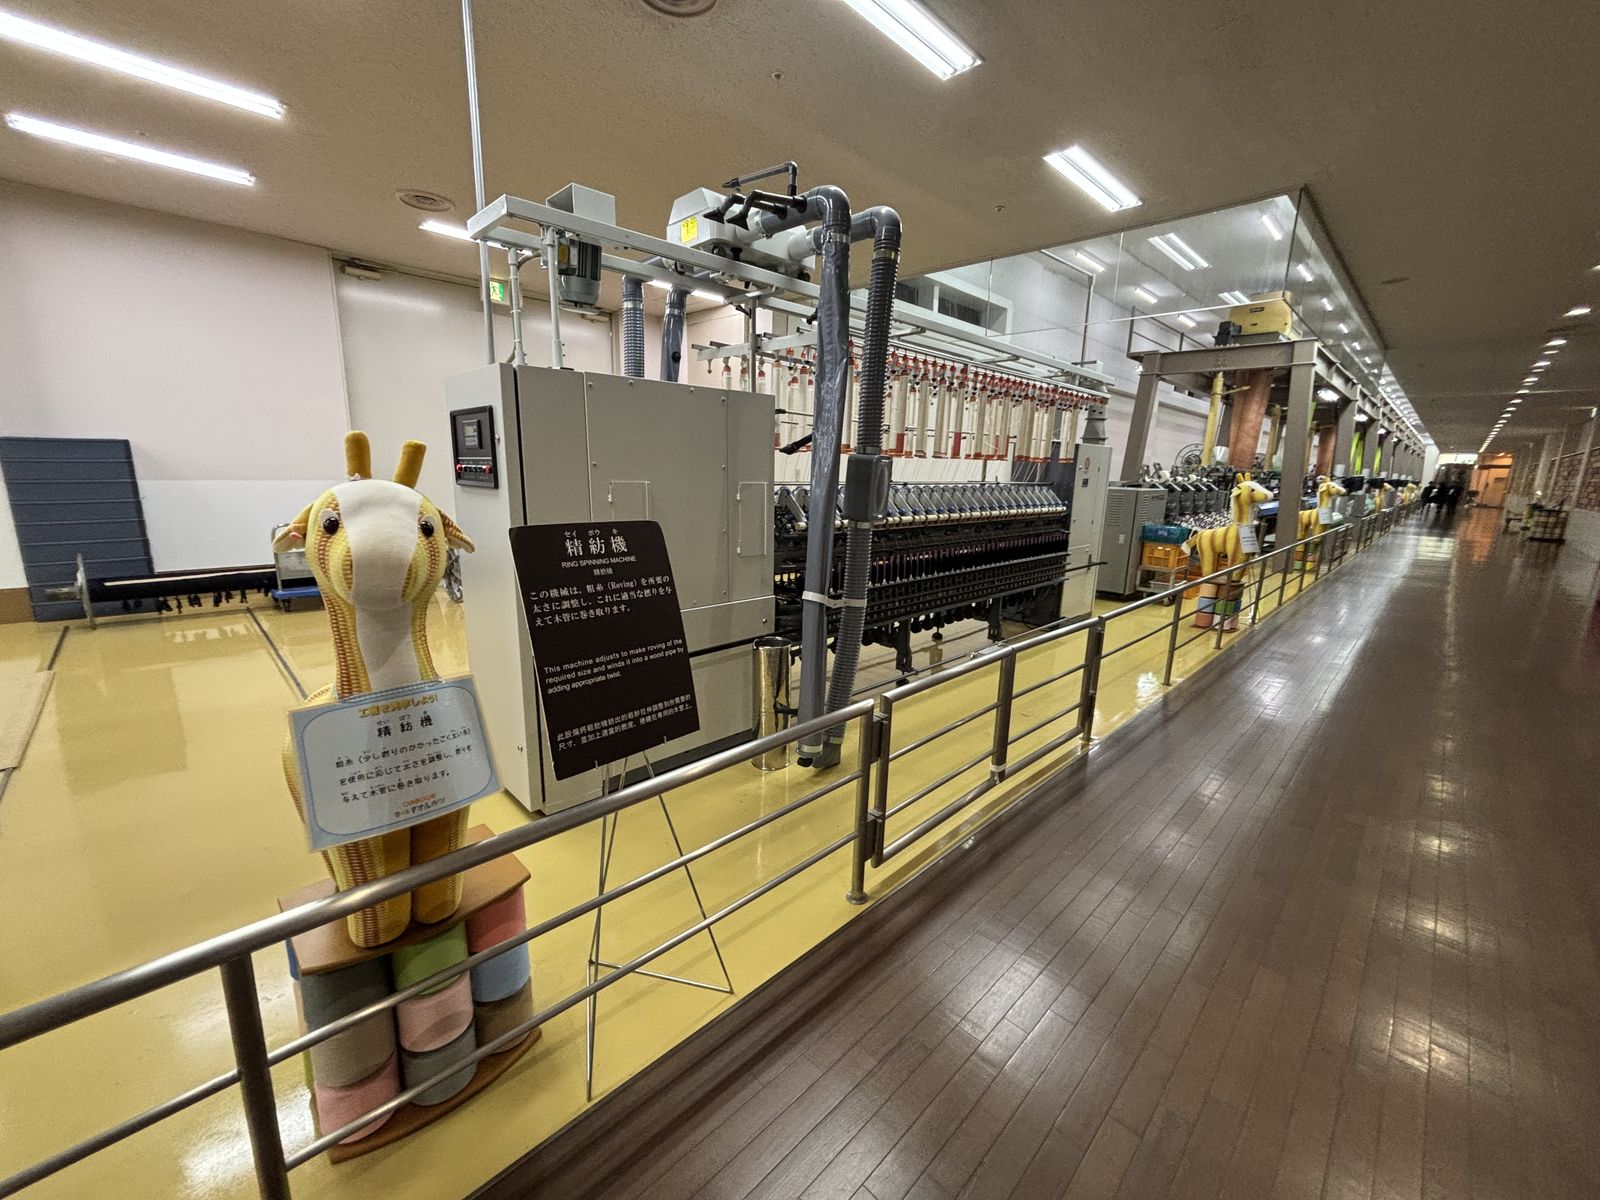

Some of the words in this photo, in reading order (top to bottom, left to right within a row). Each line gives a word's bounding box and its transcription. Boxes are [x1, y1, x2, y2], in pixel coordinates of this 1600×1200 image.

[564, 530, 577, 538] セイ
[565, 535, 628, 557] 精紡機
[561, 560, 579, 569] RING
[580, 557, 610, 567] SPINNING
[610, 555, 637, 564] MACHINE
[543, 665, 561, 675] This
[562, 658, 594, 671] machine
[595, 652, 620, 664] adjusts
[629, 647, 647, 656] make
[647, 641, 666, 652] roving
[545, 672, 576, 685] required
[577, 669, 592, 677] size
[593, 665, 606, 674] and
[607, 661, 626, 670] winds
[632, 656, 644, 664] into
[649, 651, 664, 660] wood
[665, 648, 677, 657] pipe
[677, 646, 684, 654] by
[547, 682, 571, 695] adding
[571, 675, 607, 689] appropriate
[607, 671, 622, 680] twist.
